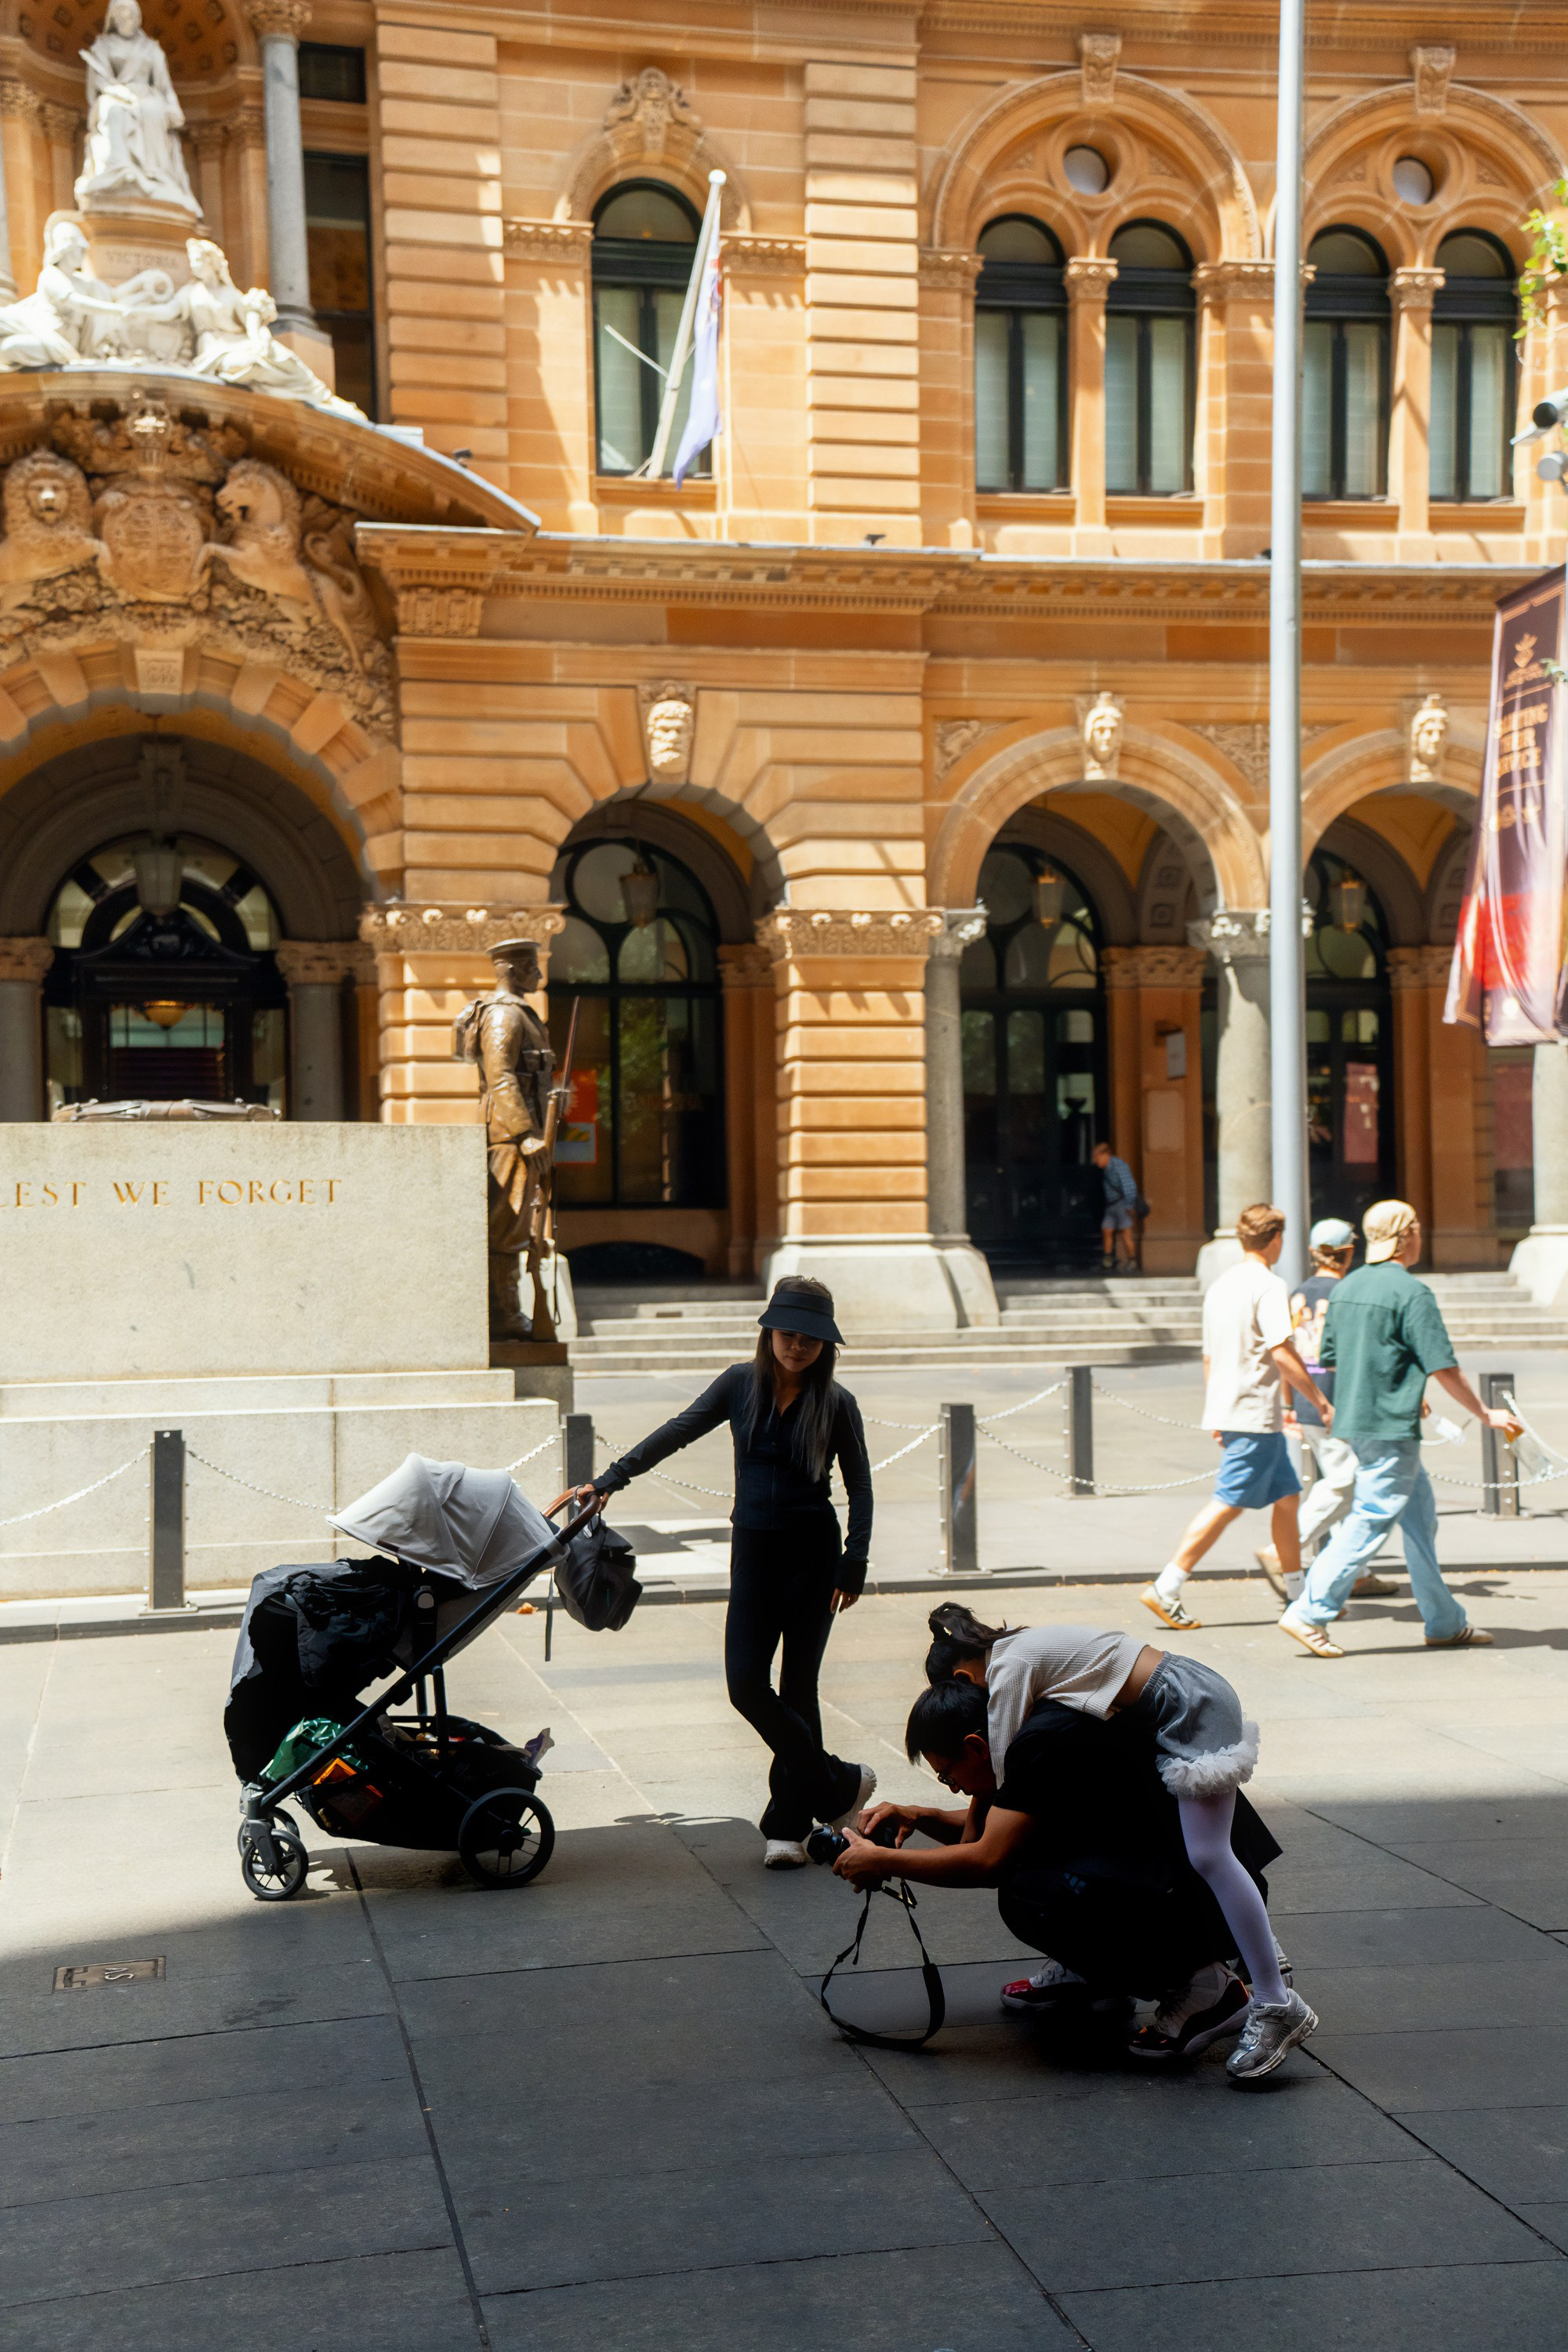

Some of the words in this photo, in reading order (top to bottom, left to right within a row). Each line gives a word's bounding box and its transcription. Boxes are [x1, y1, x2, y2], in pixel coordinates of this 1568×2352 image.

[105, 251, 179, 269] VICTORIA
[0, 1181, 86, 1208] EST
[112, 1181, 171, 1207] WE
[198, 1179, 343, 1206] FORGET
